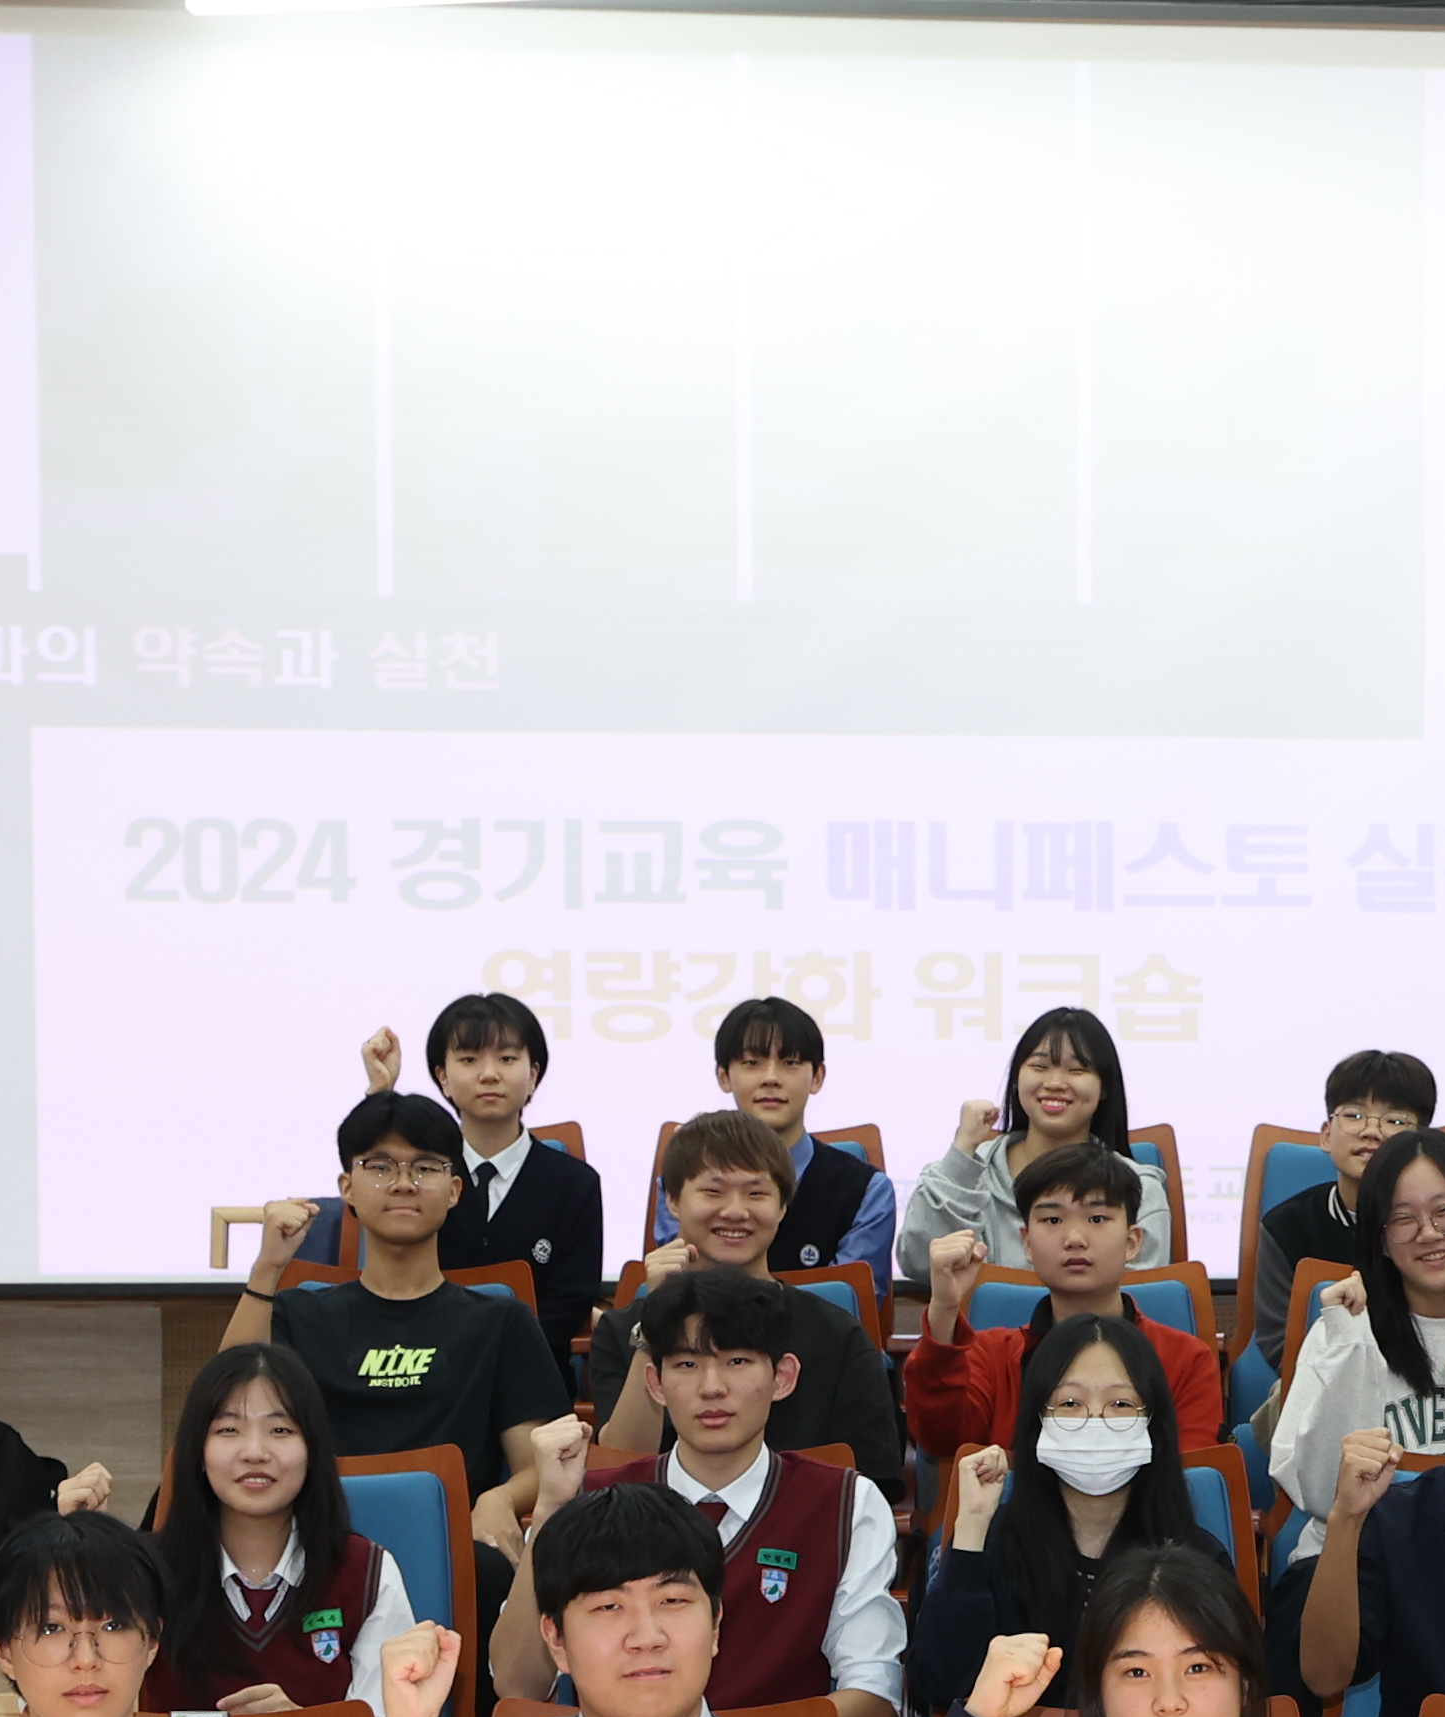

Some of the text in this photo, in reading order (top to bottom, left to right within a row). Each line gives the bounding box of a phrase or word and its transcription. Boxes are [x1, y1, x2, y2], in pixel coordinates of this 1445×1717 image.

[131, 624, 337, 689] 약속과
[367, 627, 501, 691] 실천
[124, 815, 355, 906] 2024
[389, 817, 790, 912] 경기교육
[825, 818, 1315, 915] 매니페스토
[481, 948, 1204, 1044] 역량강화 워크숍
[357, 1343, 437, 1377] NIKE
[368, 1376, 394, 1388] JUST
[394, 1376, 409, 1387] DO
